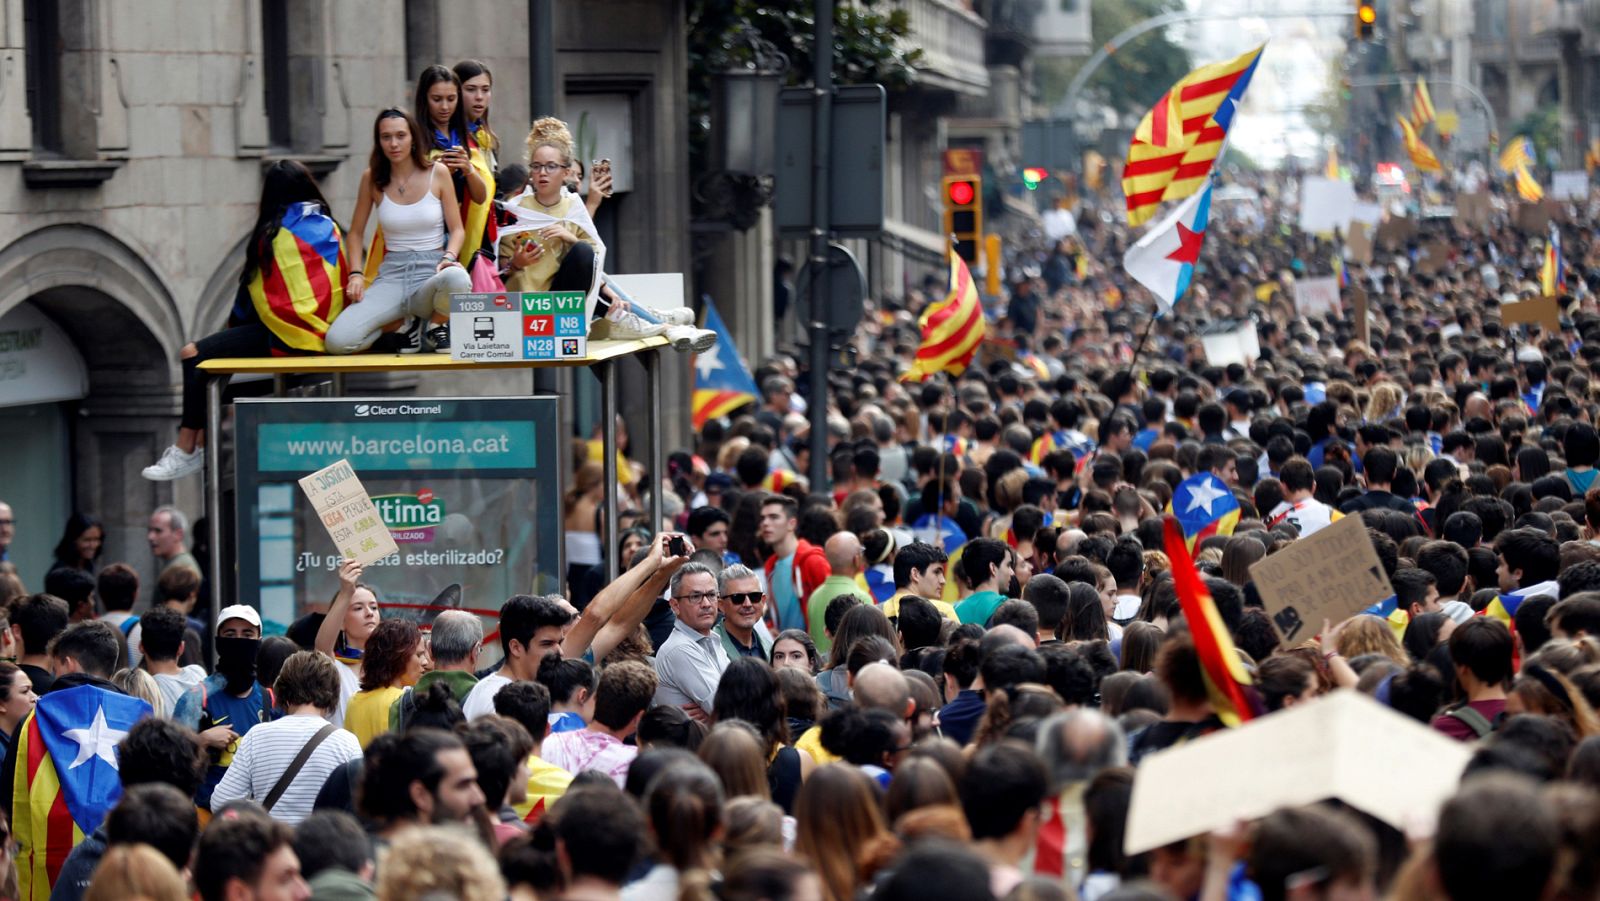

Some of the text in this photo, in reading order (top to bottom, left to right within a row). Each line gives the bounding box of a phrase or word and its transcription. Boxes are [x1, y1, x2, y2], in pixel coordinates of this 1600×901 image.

[459, 301, 484, 311] 1039
[524, 298, 552, 310] V15
[556, 297, 583, 308] V17
[530, 319, 548, 332] 47
[560, 316, 578, 328] N8
[528, 340, 554, 351] N28
[370, 404, 442, 415] Clear Channel
[288, 434, 509, 455] www.barcelona.cat
[374, 498, 440, 522] ltima
[296, 552, 320, 571] ¿Tu
[406, 549, 504, 566] esterilizado?
[1259, 562, 1284, 586] NO
